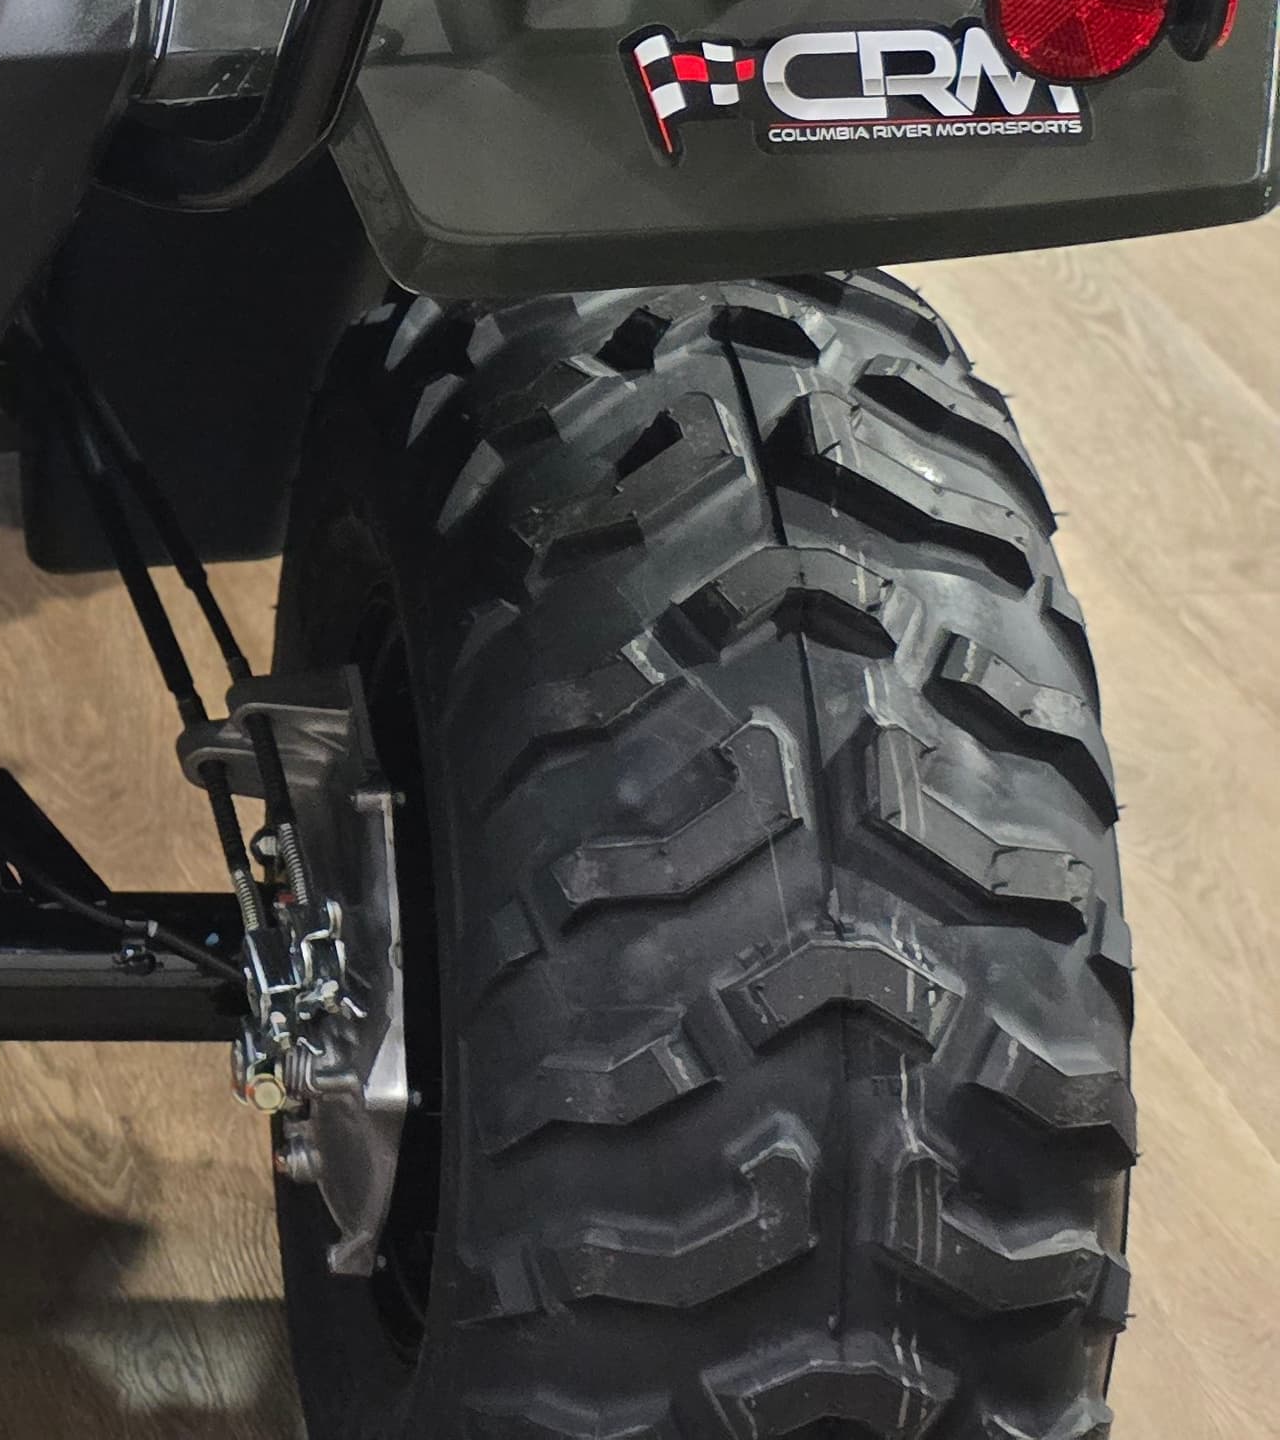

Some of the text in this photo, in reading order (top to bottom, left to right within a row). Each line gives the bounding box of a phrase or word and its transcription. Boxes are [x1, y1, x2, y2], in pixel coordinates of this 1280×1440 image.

[762, 25, 1081, 121] CRM
[768, 120, 1083, 142] COLUMBIA RIVER MOTORSPORTS
